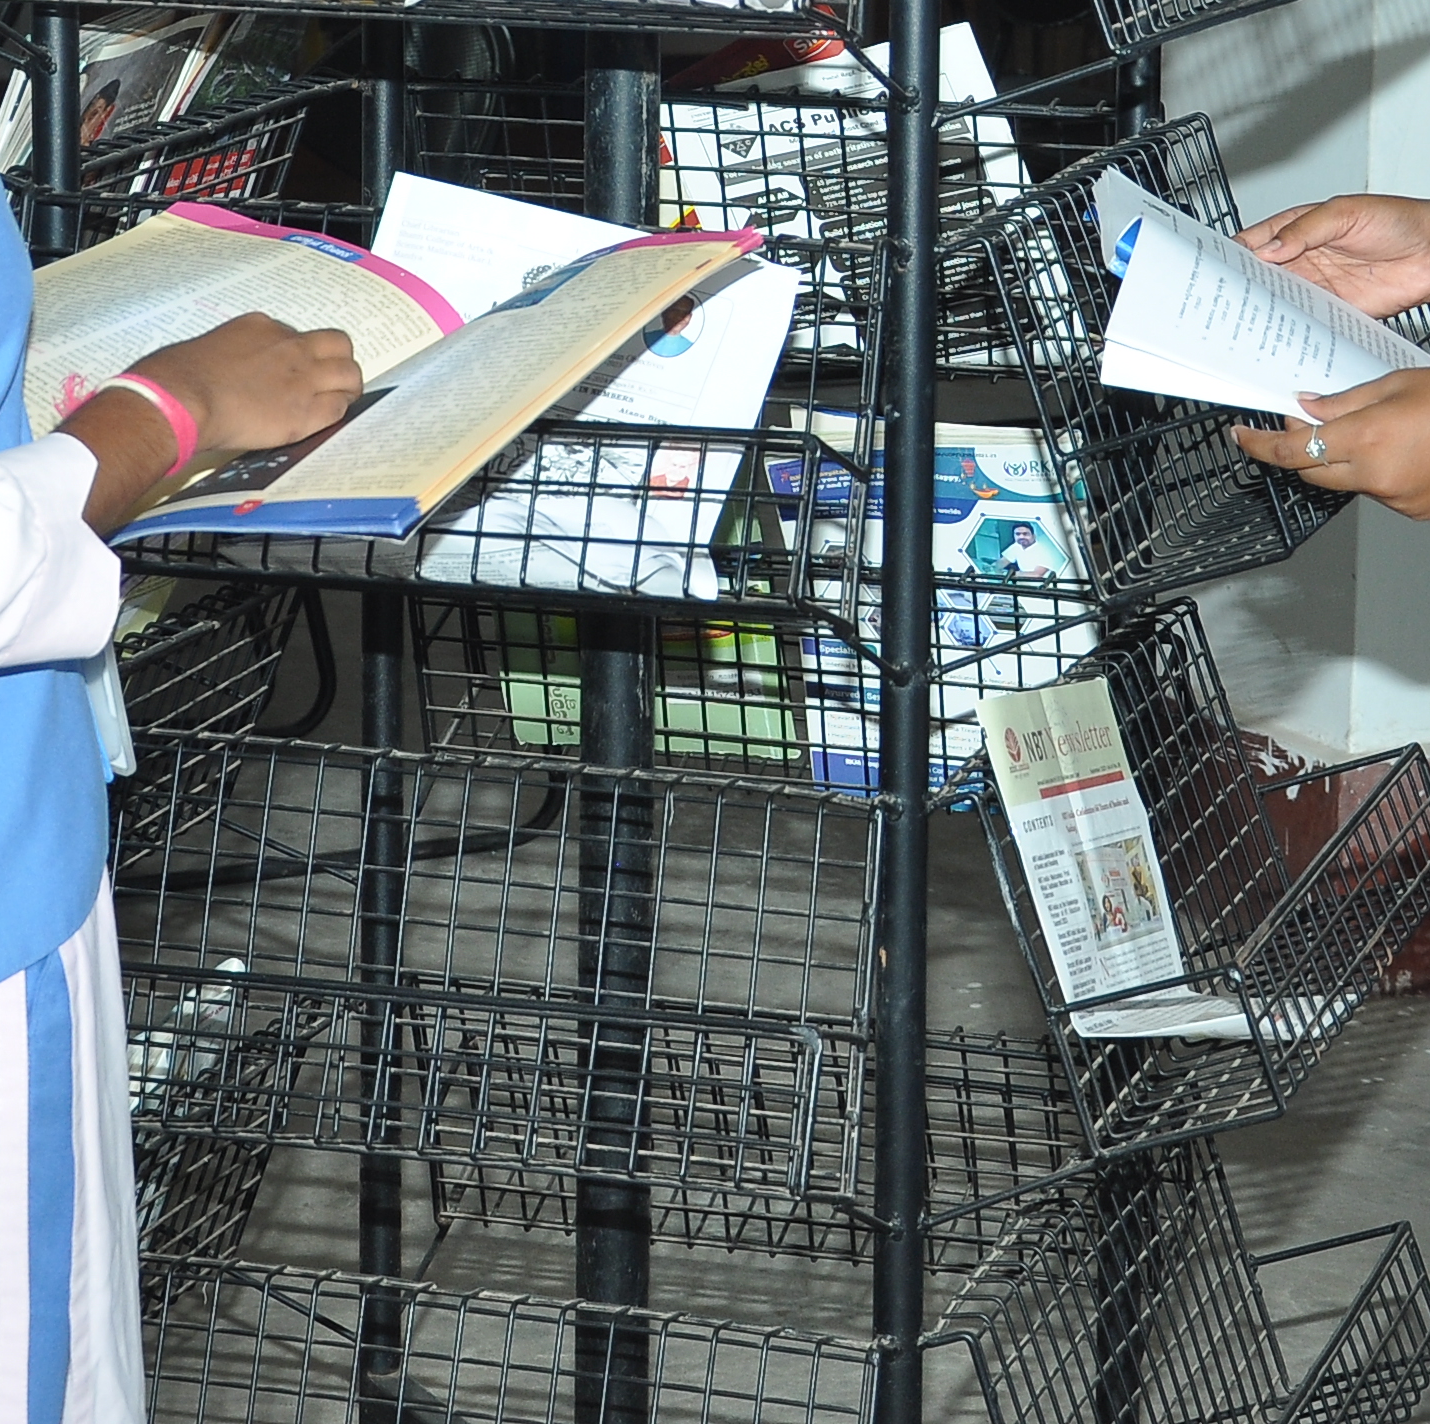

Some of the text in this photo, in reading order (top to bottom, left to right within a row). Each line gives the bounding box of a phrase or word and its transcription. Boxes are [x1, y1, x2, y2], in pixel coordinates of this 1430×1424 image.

[768, 116, 806, 134] ACS
[824, 142, 878, 158] authritative
[423, 223, 460, 237] Librarian
[396, 239, 424, 251] Science
[426, 234, 454, 247] College
[469, 243, 484, 253] Arts
[592, 389, 635, 404] NUMBERS
[824, 688, 860, 699] Ayurved
[1022, 728, 1049, 764] NBT
[1022, 815, 1054, 834] CONTENTS
